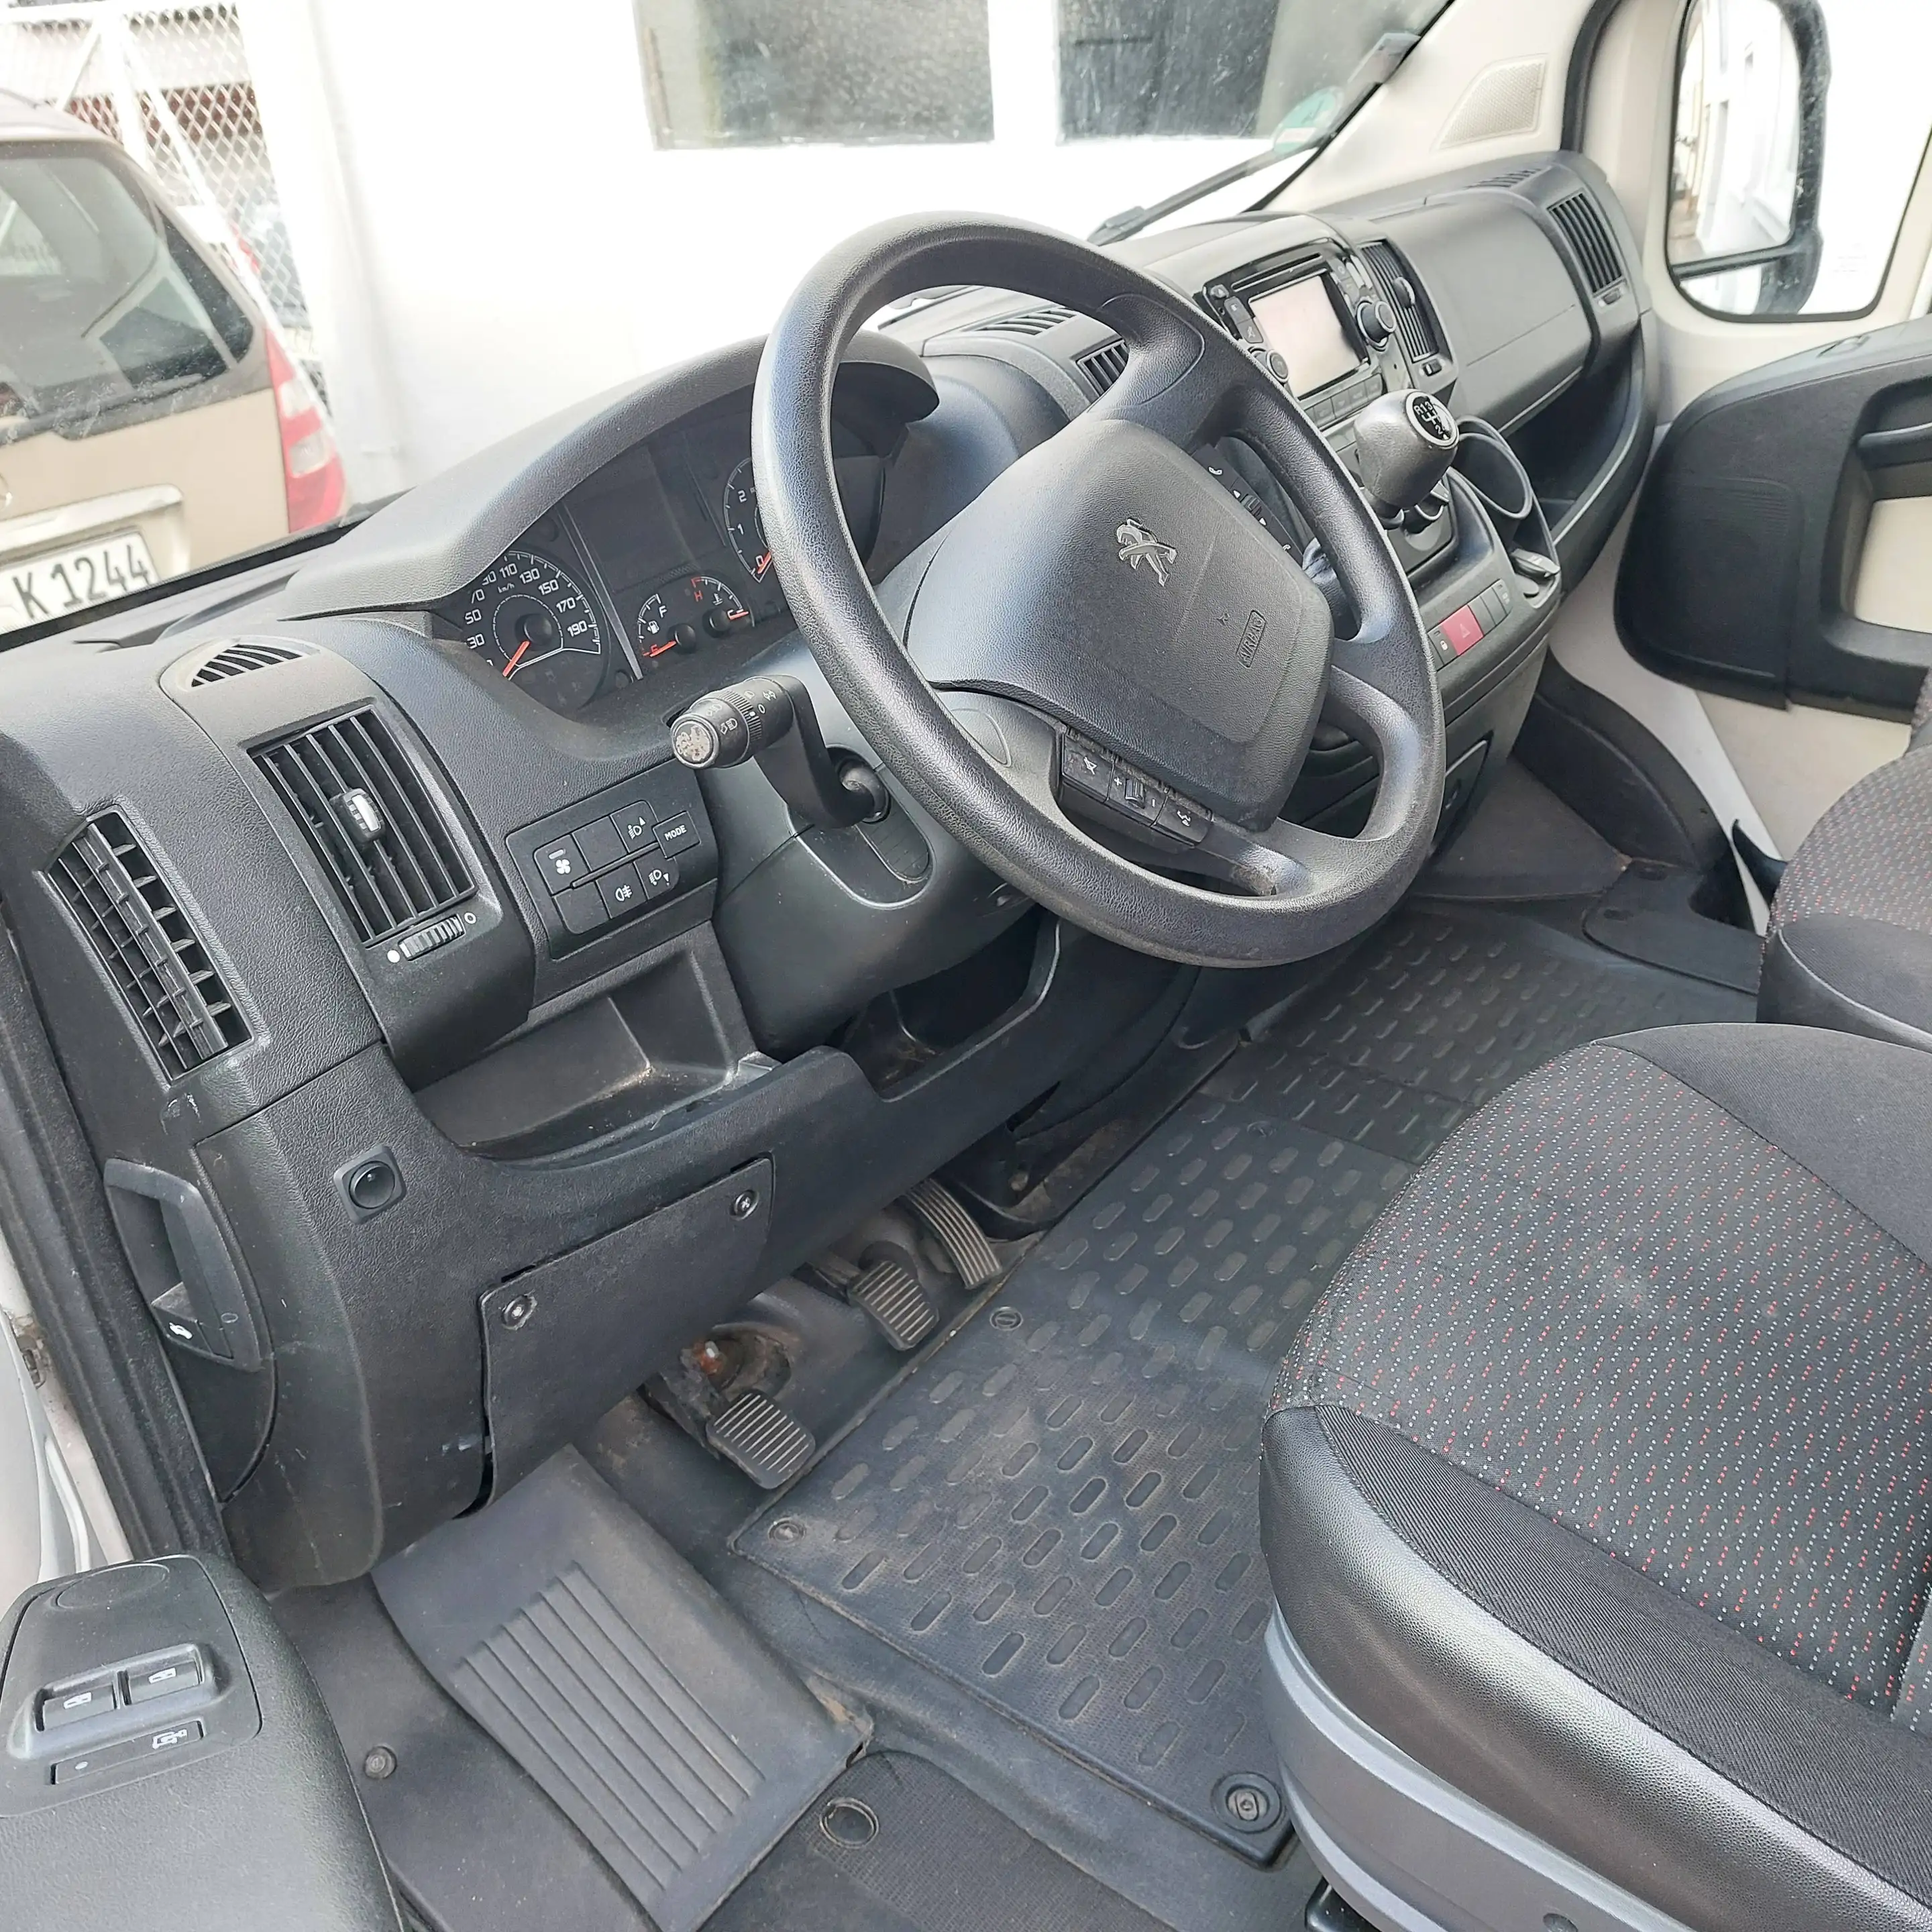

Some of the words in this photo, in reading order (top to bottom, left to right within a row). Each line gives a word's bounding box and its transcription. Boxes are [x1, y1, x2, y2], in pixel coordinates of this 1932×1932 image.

[738, 490, 747, 503] 2
[737, 523, 744, 535] 1
[499, 563, 518, 578] 110
[519, 568, 541, 584] 130
[12, 572, 49, 619] K
[50, 545, 150, 608] 1244
[538, 579, 559, 596] 150
[694, 590, 704, 602] H
[556, 596, 576, 613] 170
[659, 605, 667, 619] F
[465, 608, 482, 625] 50
[568, 620, 588, 637] 190
[467, 633, 485, 649] 30
[664, 824, 688, 841] MODE
